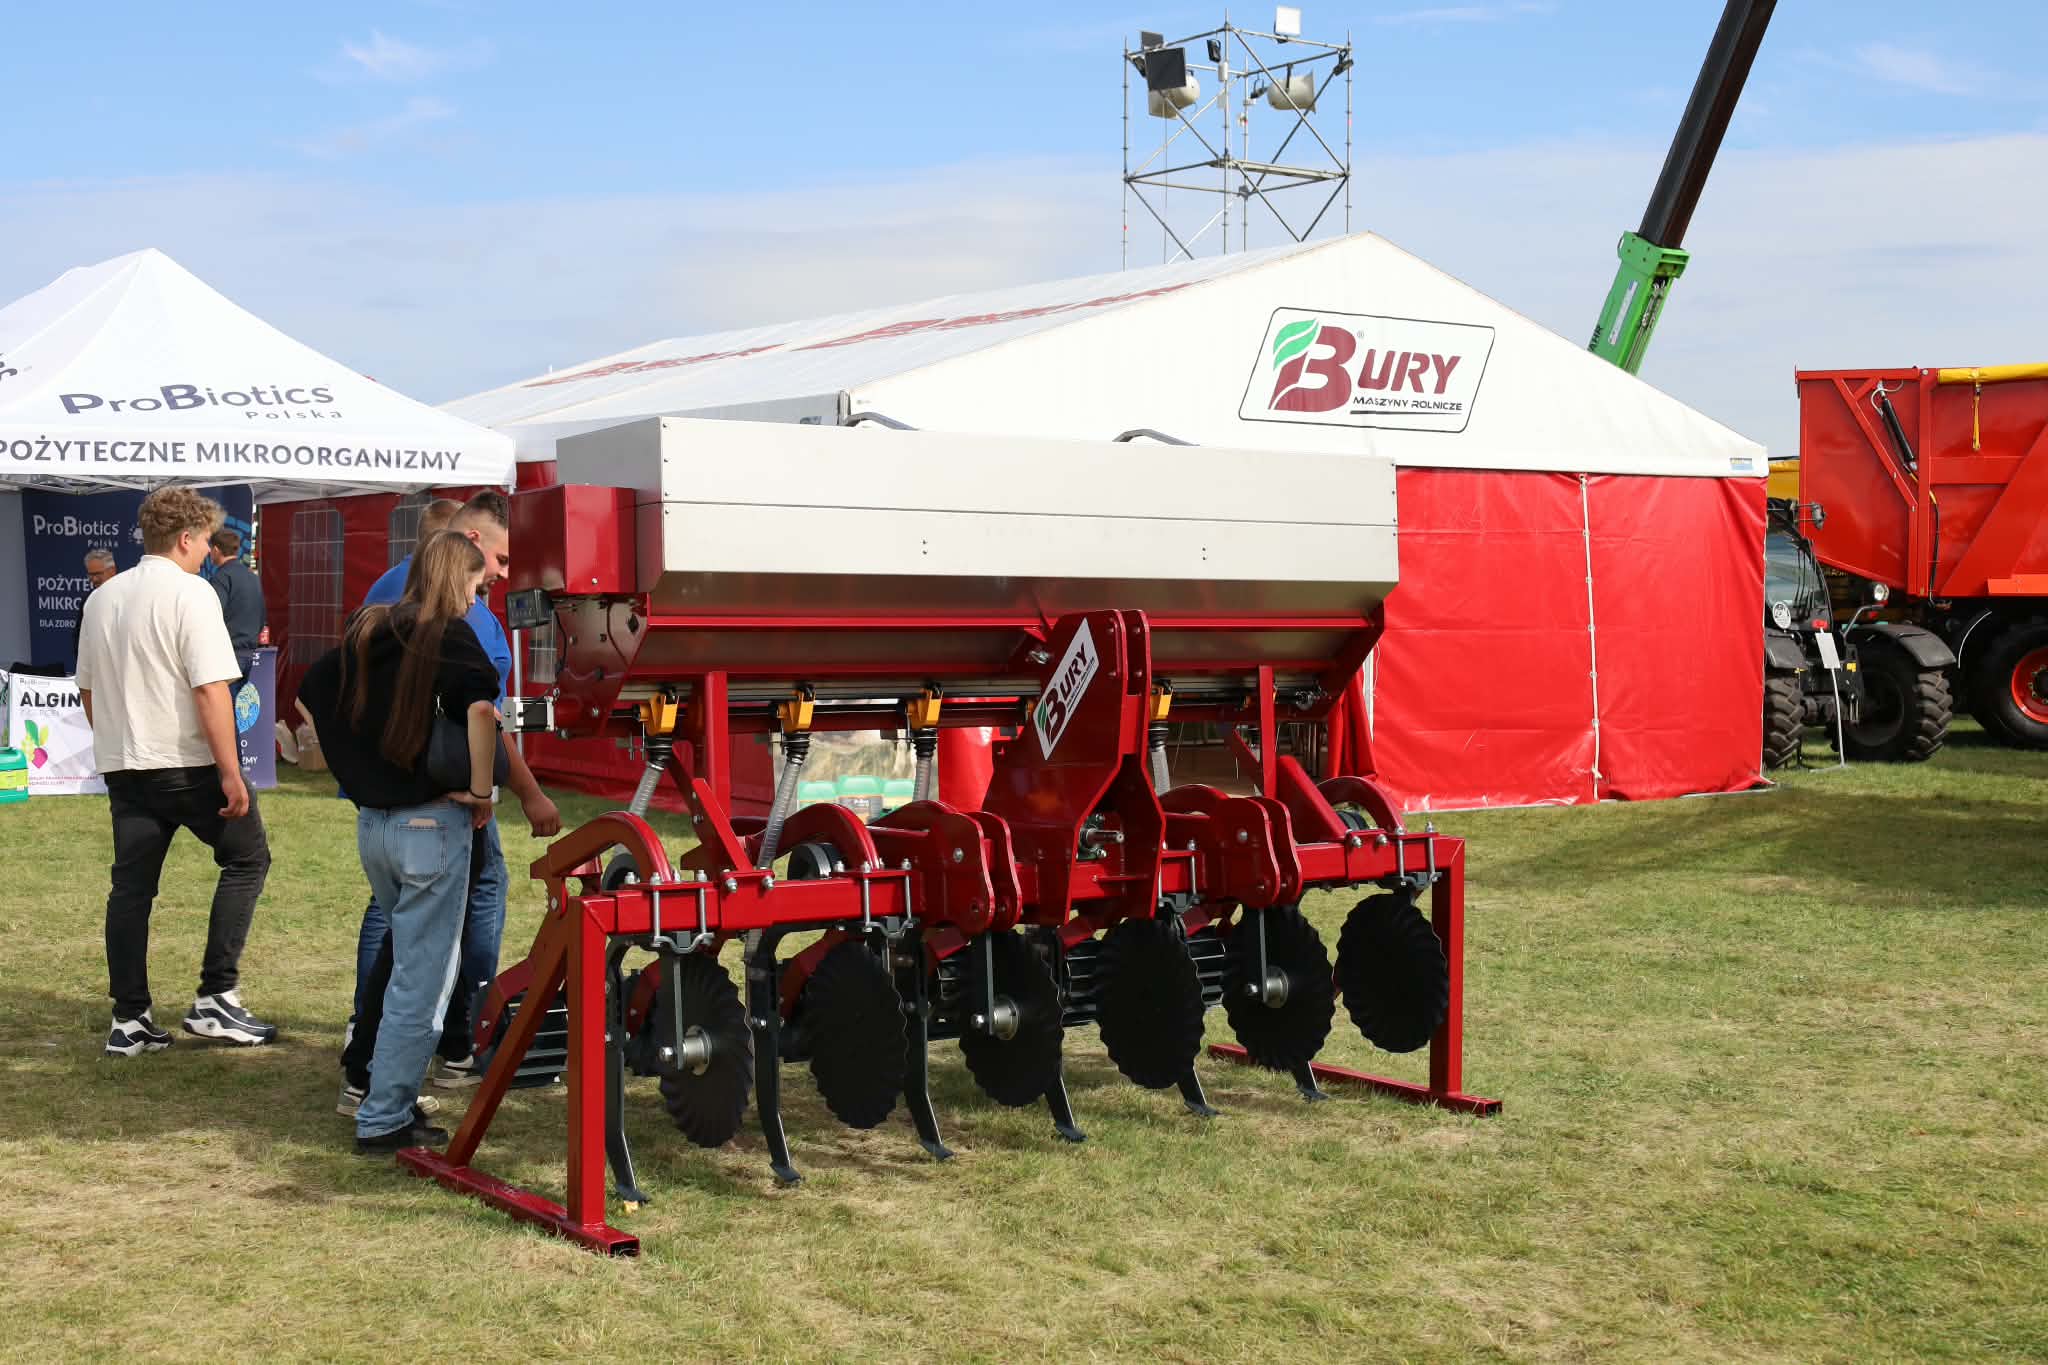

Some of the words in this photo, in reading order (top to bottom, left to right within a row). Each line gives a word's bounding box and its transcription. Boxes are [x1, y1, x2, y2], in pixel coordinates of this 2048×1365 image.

[1268, 325, 1462, 413] BURY
[59, 384, 335, 415] ProBiotics
[1353, 396, 1409, 408] MASZYNY
[1411, 400, 1463, 411] ROLNICZE
[245, 409, 343, 420] Polska
[196, 442, 462, 471] MIKROORGANIZMY
[33, 514, 119, 536] ProBiotics
[87, 539, 119, 548] Polska
[1045, 641, 1088, 746] BURY
